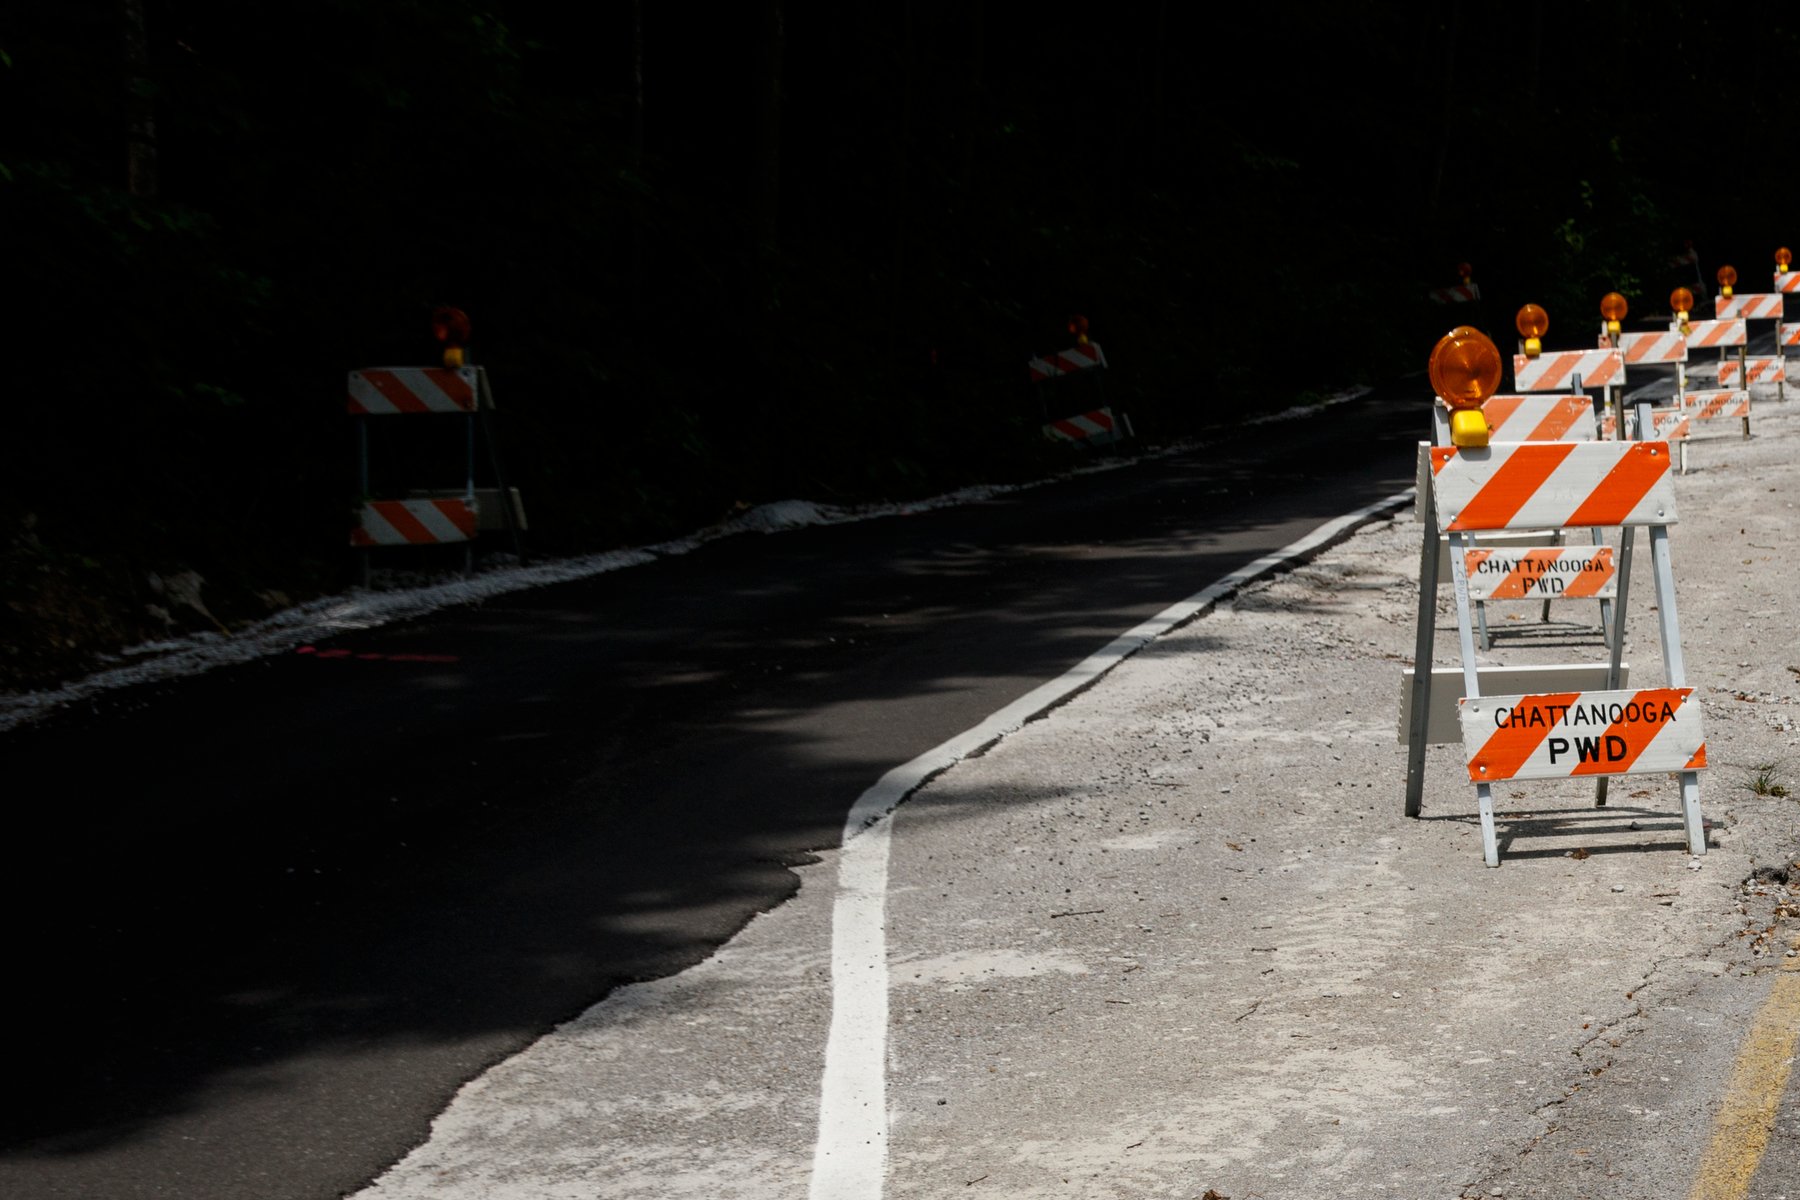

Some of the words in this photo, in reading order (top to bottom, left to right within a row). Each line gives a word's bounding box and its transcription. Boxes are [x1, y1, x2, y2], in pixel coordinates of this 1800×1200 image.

[1477, 559, 1604, 574] CHATTANOOGA
[1522, 577, 1565, 594] PWD
[1494, 701, 1677, 729] CHATTANOOGA
[1548, 735, 1628, 765] PWD
